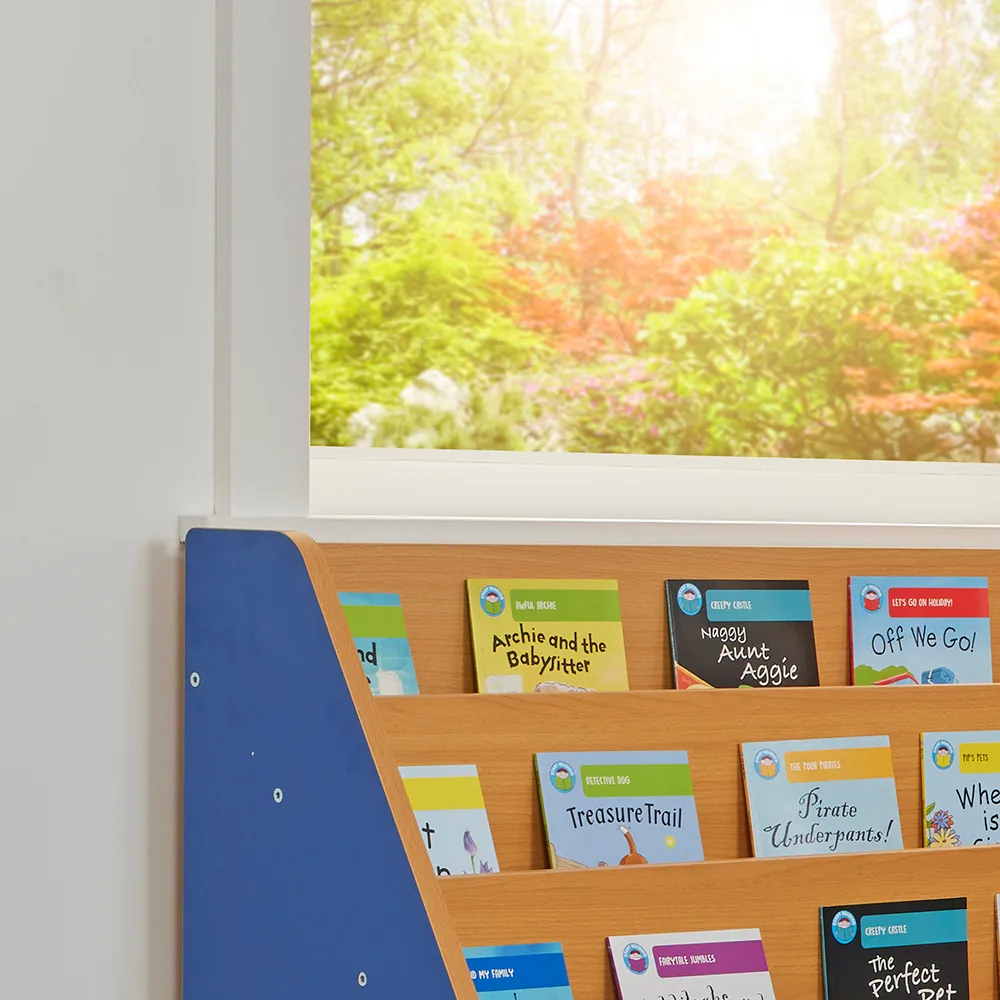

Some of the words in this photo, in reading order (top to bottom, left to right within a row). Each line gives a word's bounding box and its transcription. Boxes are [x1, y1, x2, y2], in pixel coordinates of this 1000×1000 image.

[710, 600, 731, 610] CREEPY
[733, 600, 752, 610] CASTLE
[892, 598, 906, 607] LET'S
[908, 598, 917, 607] GO
[918, 598, 927, 607] ON
[492, 623, 546, 652] Archie
[548, 632, 578, 652] and
[581, 633, 607, 653] the
[700, 626, 747, 644] Naggy
[871, 625, 905, 656] Off
[910, 624, 937, 648] We
[943, 626, 977, 652] Go!
[357, 641, 379, 666] nd
[506, 650, 590, 676] Babysitter
[718, 642, 770, 664] Aunt
[740, 656, 798, 686] Aggie
[790, 762, 802, 772] THE
[803, 761, 818, 771] POOR
[819, 760, 842, 770] PIRATES
[976, 753, 989, 762] PETS
[585, 775, 616, 786] DETECTIVE
[616, 775, 631, 785] DOG
[798, 787, 858, 819] Pirate
[566, 804, 644, 829] Treasure
[644, 803, 684, 829] Trail
[983, 810, 1000, 831] is
[763, 819, 894, 852] Underpants!
[864, 926, 886, 936] CREEPY
[888, 924, 908, 934] CASTLE
[658, 955, 689, 966] FAIRYTALE
[690, 954, 717, 964] JUMBLES
[868, 955, 895, 974] The
[478, 970, 490, 980] MY
[491, 968, 514, 979] FAMILY
[868, 961, 940, 998] Perfect
